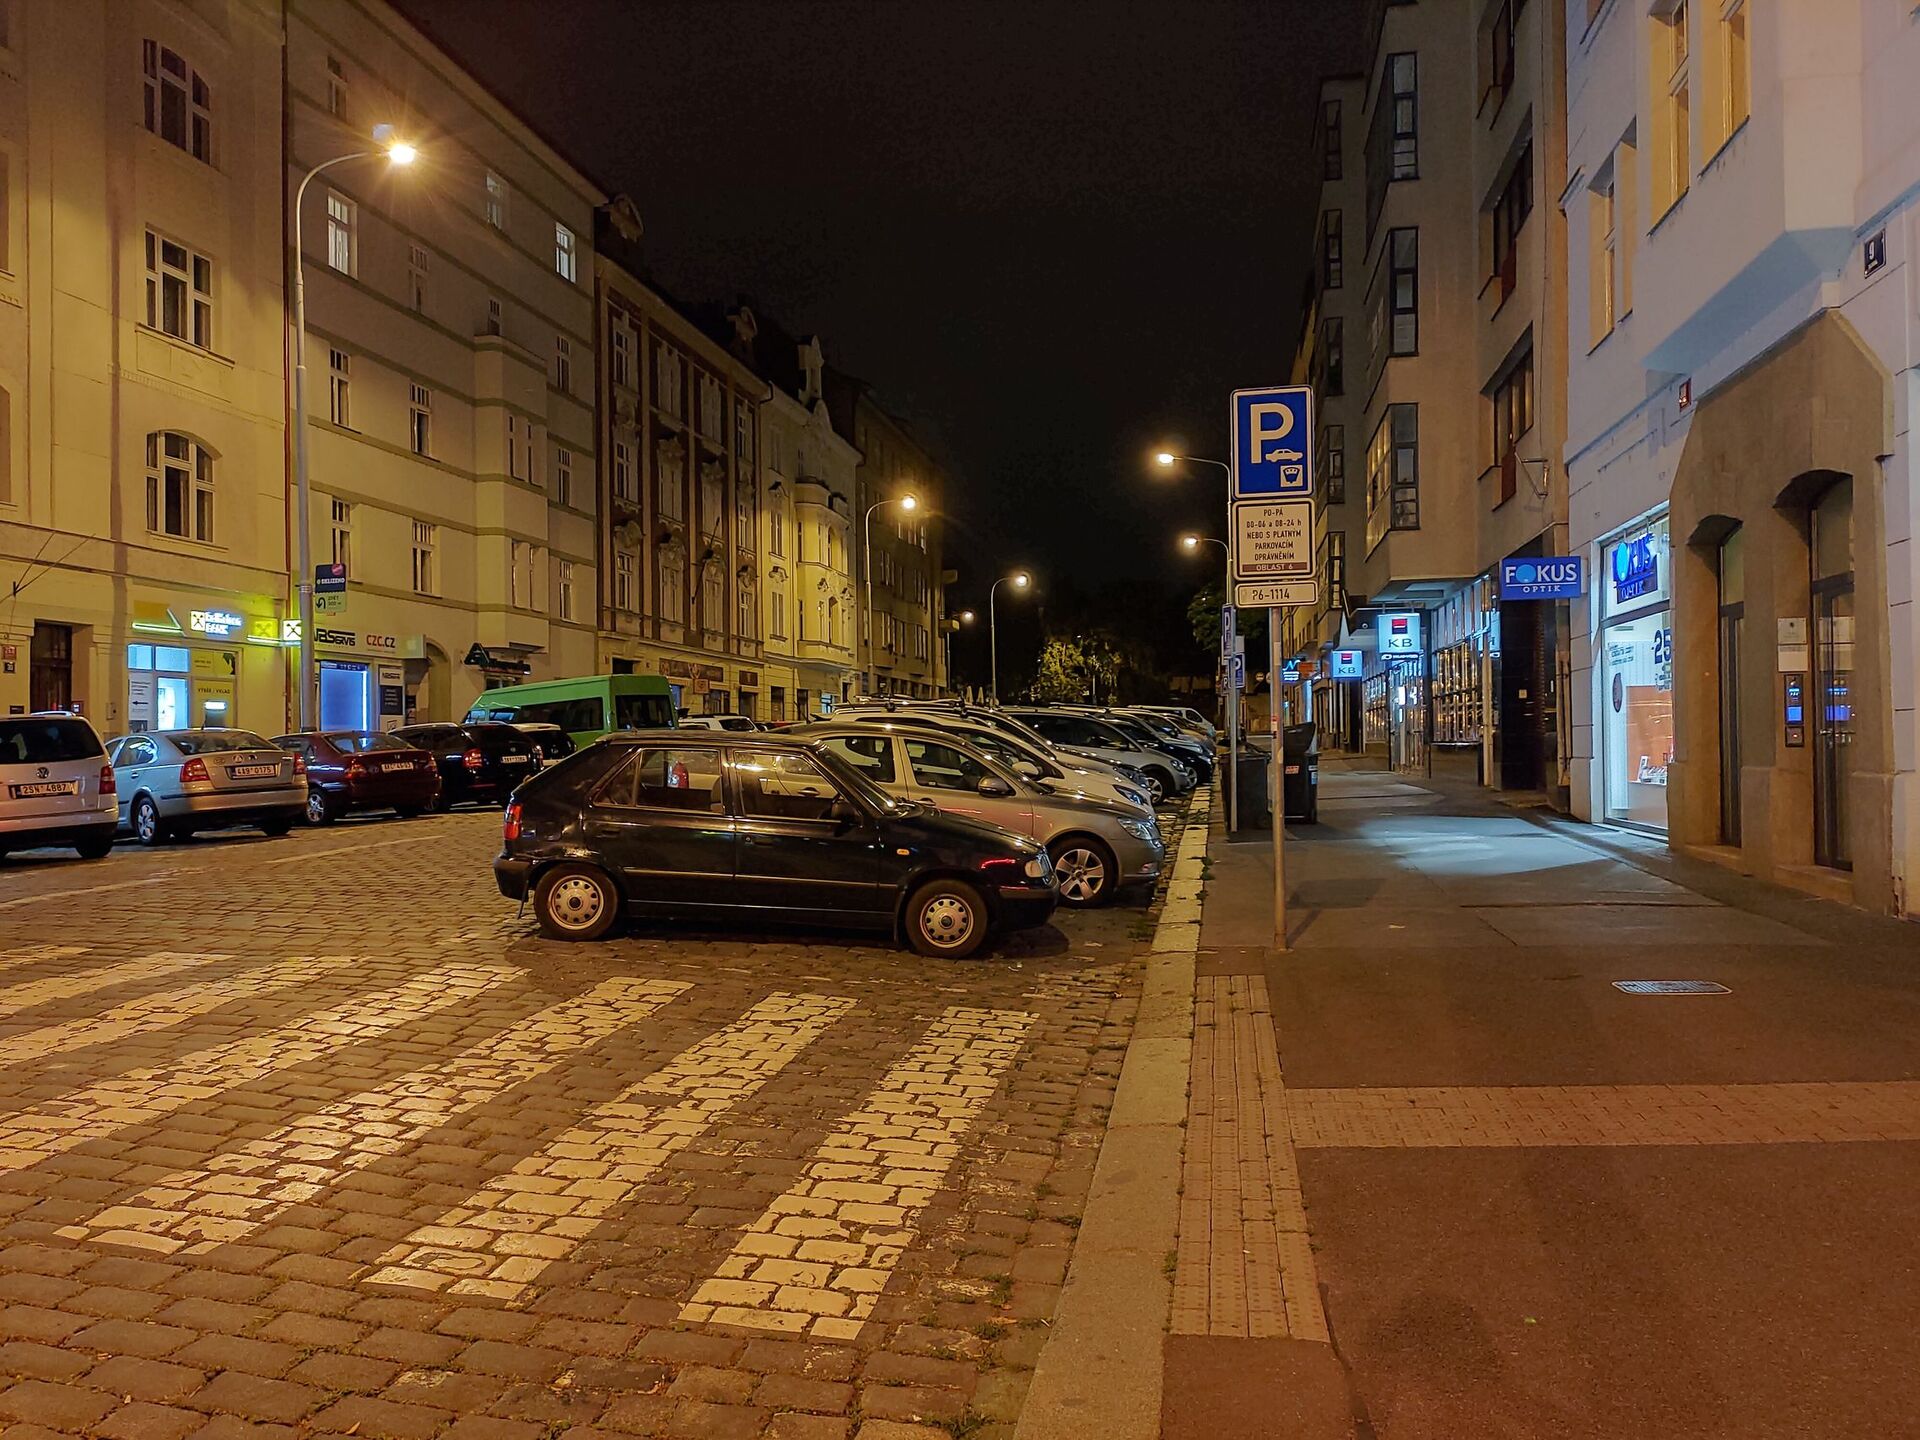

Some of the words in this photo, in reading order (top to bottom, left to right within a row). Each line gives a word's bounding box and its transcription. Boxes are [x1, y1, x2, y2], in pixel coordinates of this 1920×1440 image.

[1250, 402, 1294, 464] P
[1263, 508, 1283, 516] PO-PÁ
[1275, 519, 1295, 527] 08-24
[1246, 531, 1264, 540] NEBO
[1266, 531, 1271, 539] S
[1273, 528, 1302, 538] PLATNÝM
[1255, 540, 1294, 550] PARKOVACÍM
[1254, 551, 1295, 561] OPRÁVNĚNÍM
[1256, 563, 1285, 571] OBLAST
[1505, 562, 1578, 584] FOKUS
[1252, 588, 1290, 601] P6-1114
[1522, 585, 1561, 594] OPTIK
[366, 634, 396, 649] CZC.CZ
[1388, 638, 1413, 648] KB
